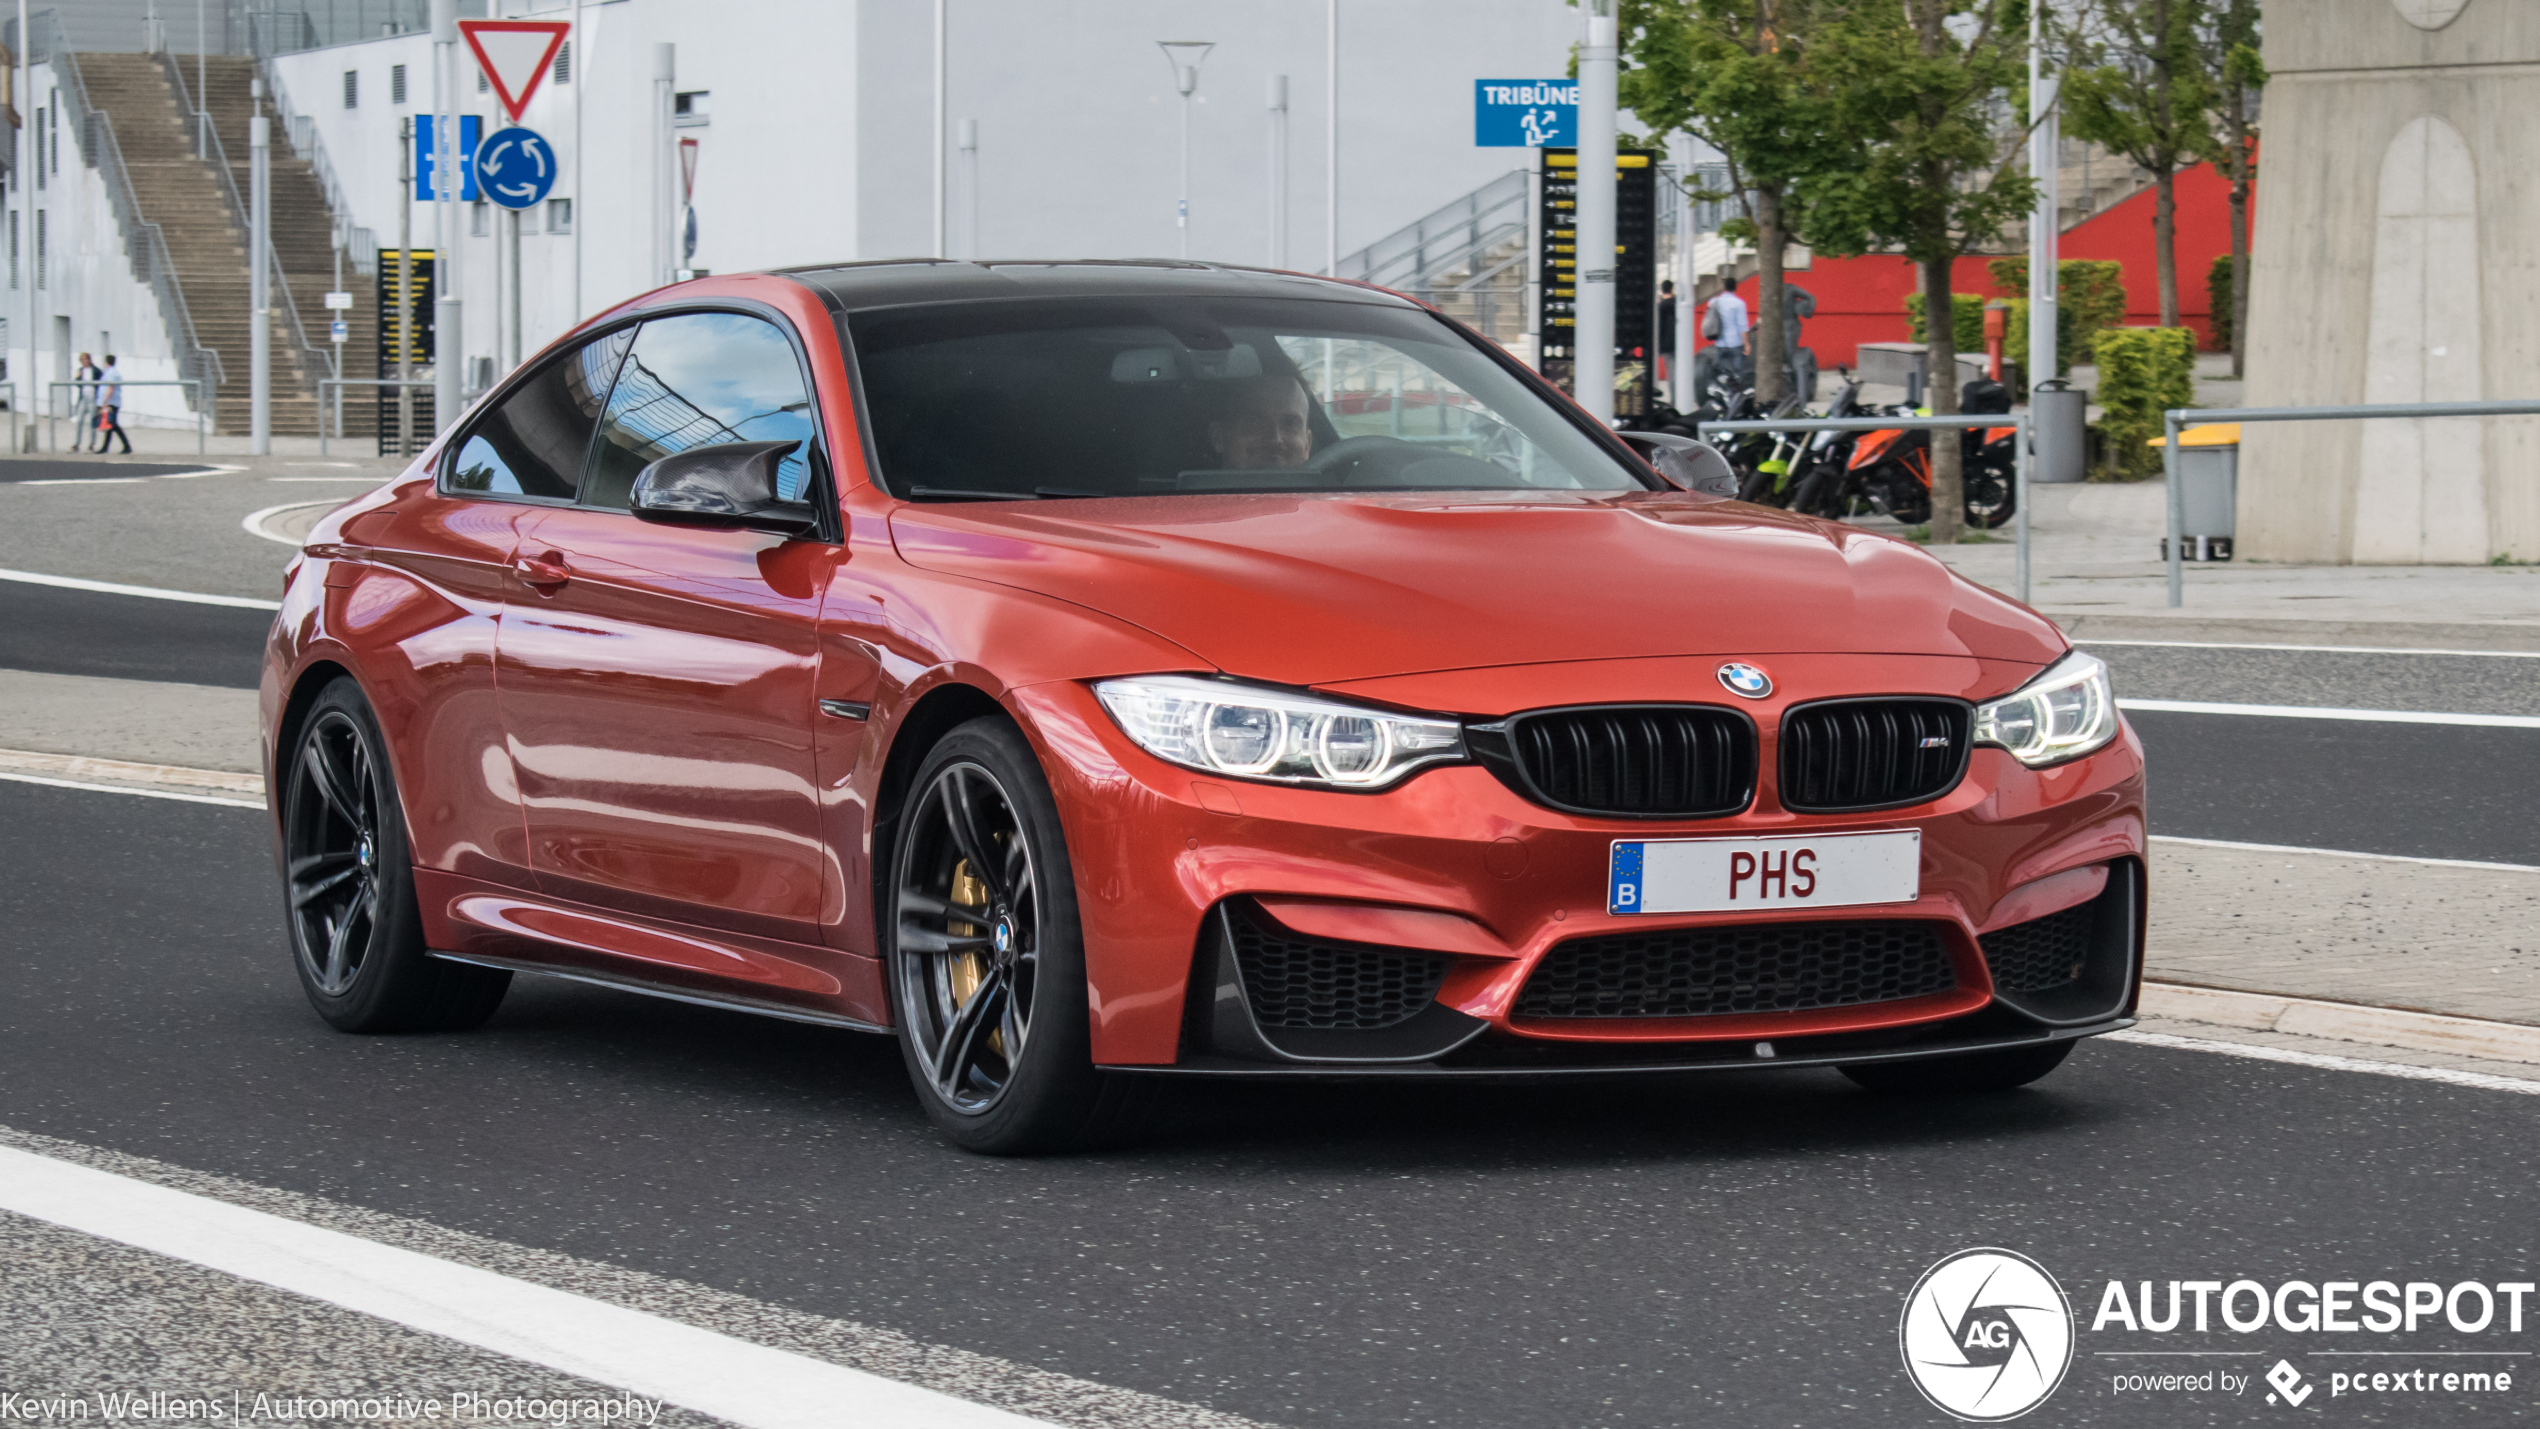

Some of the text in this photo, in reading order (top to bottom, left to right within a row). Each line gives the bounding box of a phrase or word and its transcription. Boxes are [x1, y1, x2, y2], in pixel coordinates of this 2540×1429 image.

[1483, 82, 1580, 105] TRIBÜNE
[1617, 848, 1817, 905] B PHS
